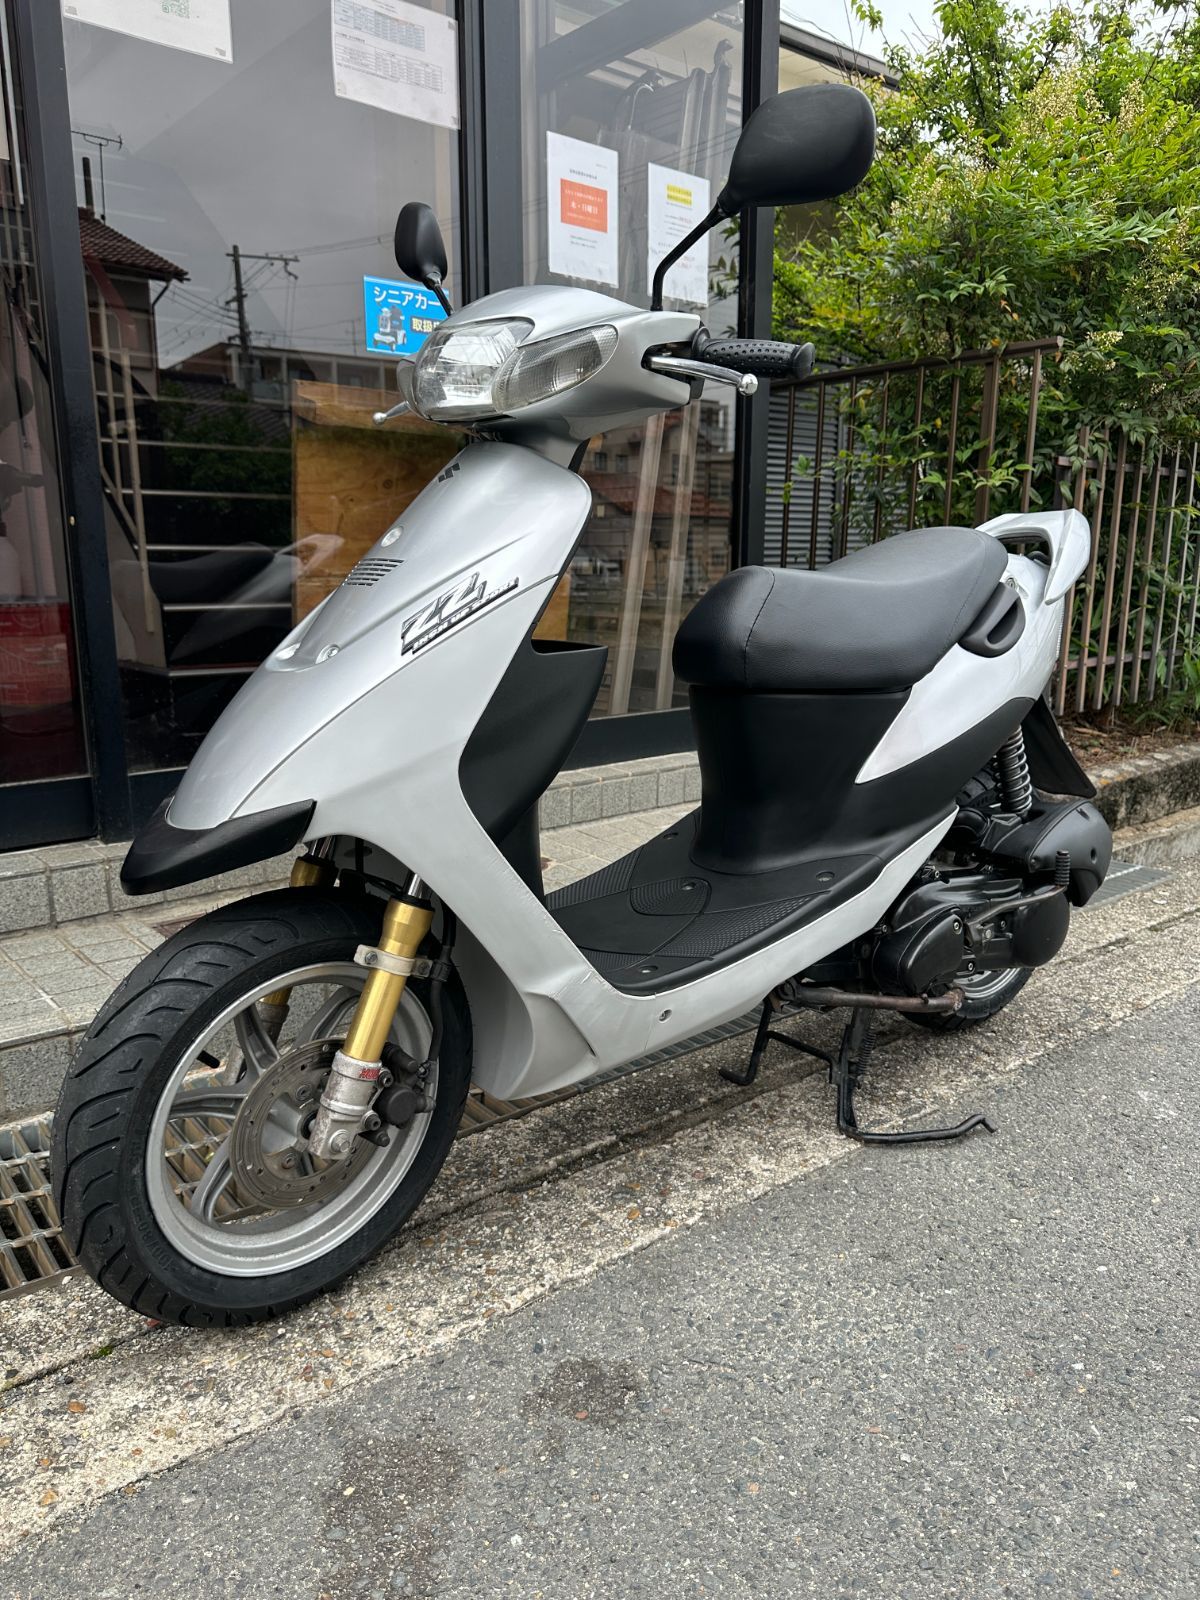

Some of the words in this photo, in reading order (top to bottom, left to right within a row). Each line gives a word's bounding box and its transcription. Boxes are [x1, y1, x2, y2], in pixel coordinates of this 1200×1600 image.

[373, 286, 441, 310] シニアカー
[401, 571, 487, 656] ZZ
